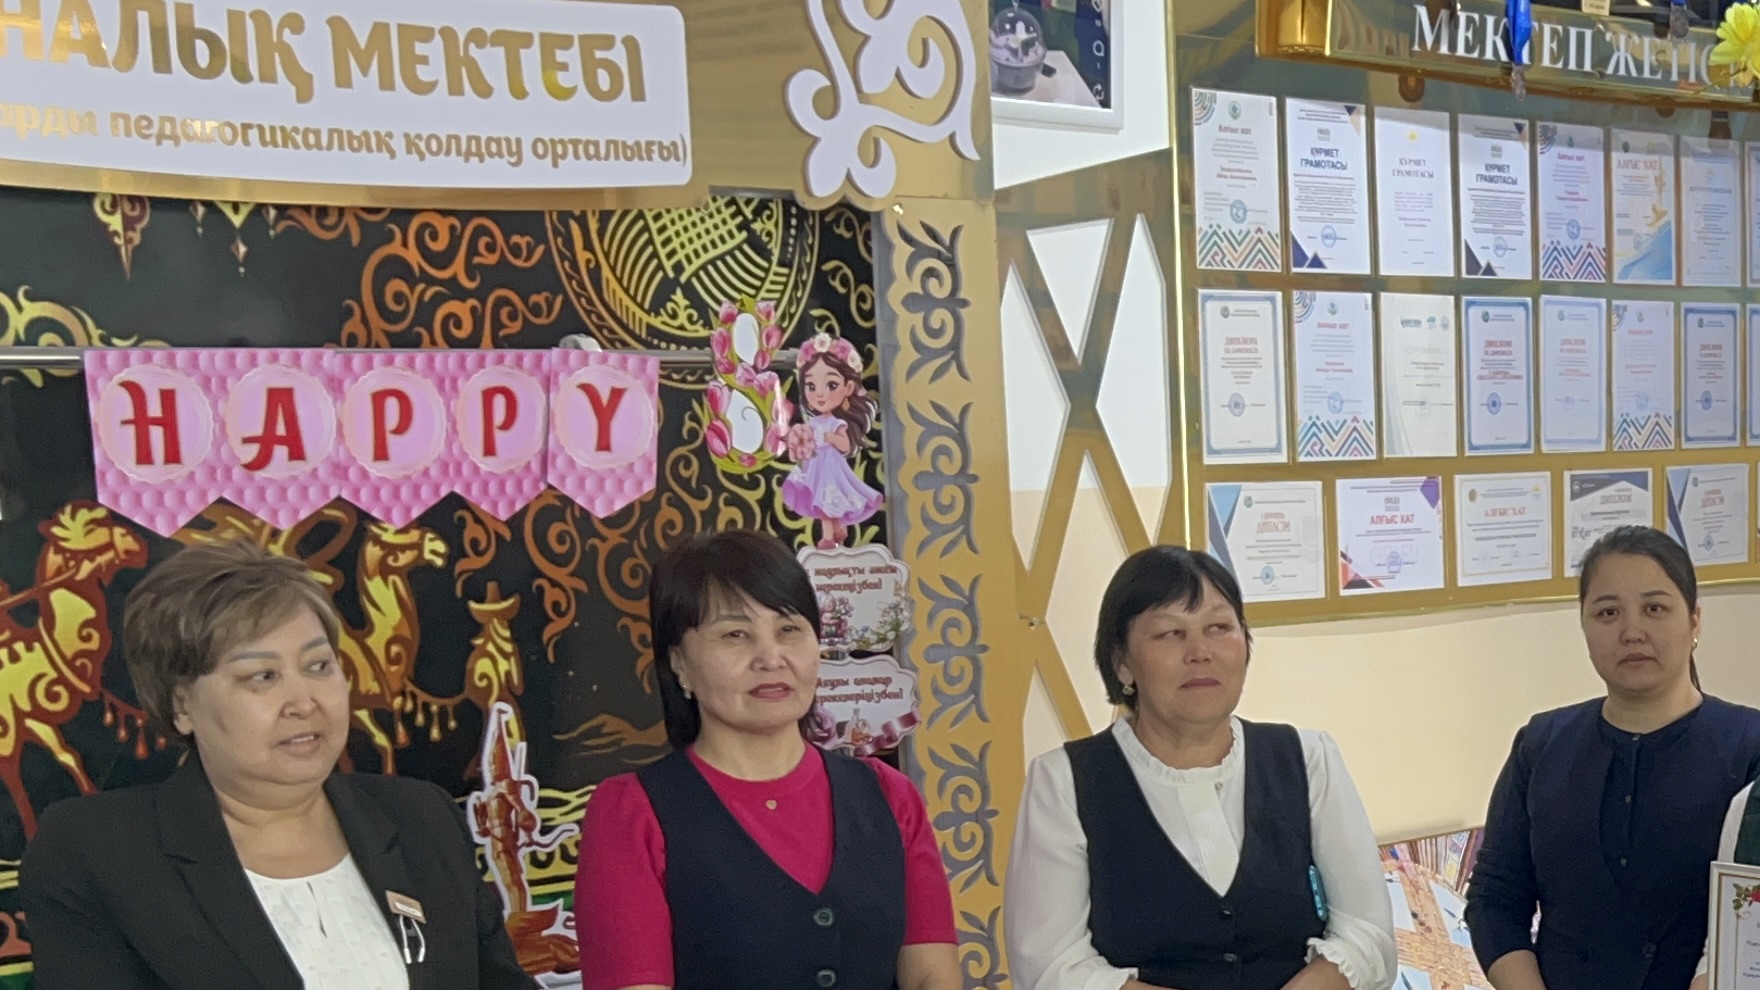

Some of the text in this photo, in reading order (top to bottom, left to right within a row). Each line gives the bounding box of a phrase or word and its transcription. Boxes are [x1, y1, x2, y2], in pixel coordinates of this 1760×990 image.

[326, 15, 647, 102] МЕКТЕБІ
[110, 112, 396, 160] педагогикалық
[404, 132, 523, 168] қолдау
[532, 132, 687, 168] орталығы)
[118, 380, 627, 472] HAPPY
